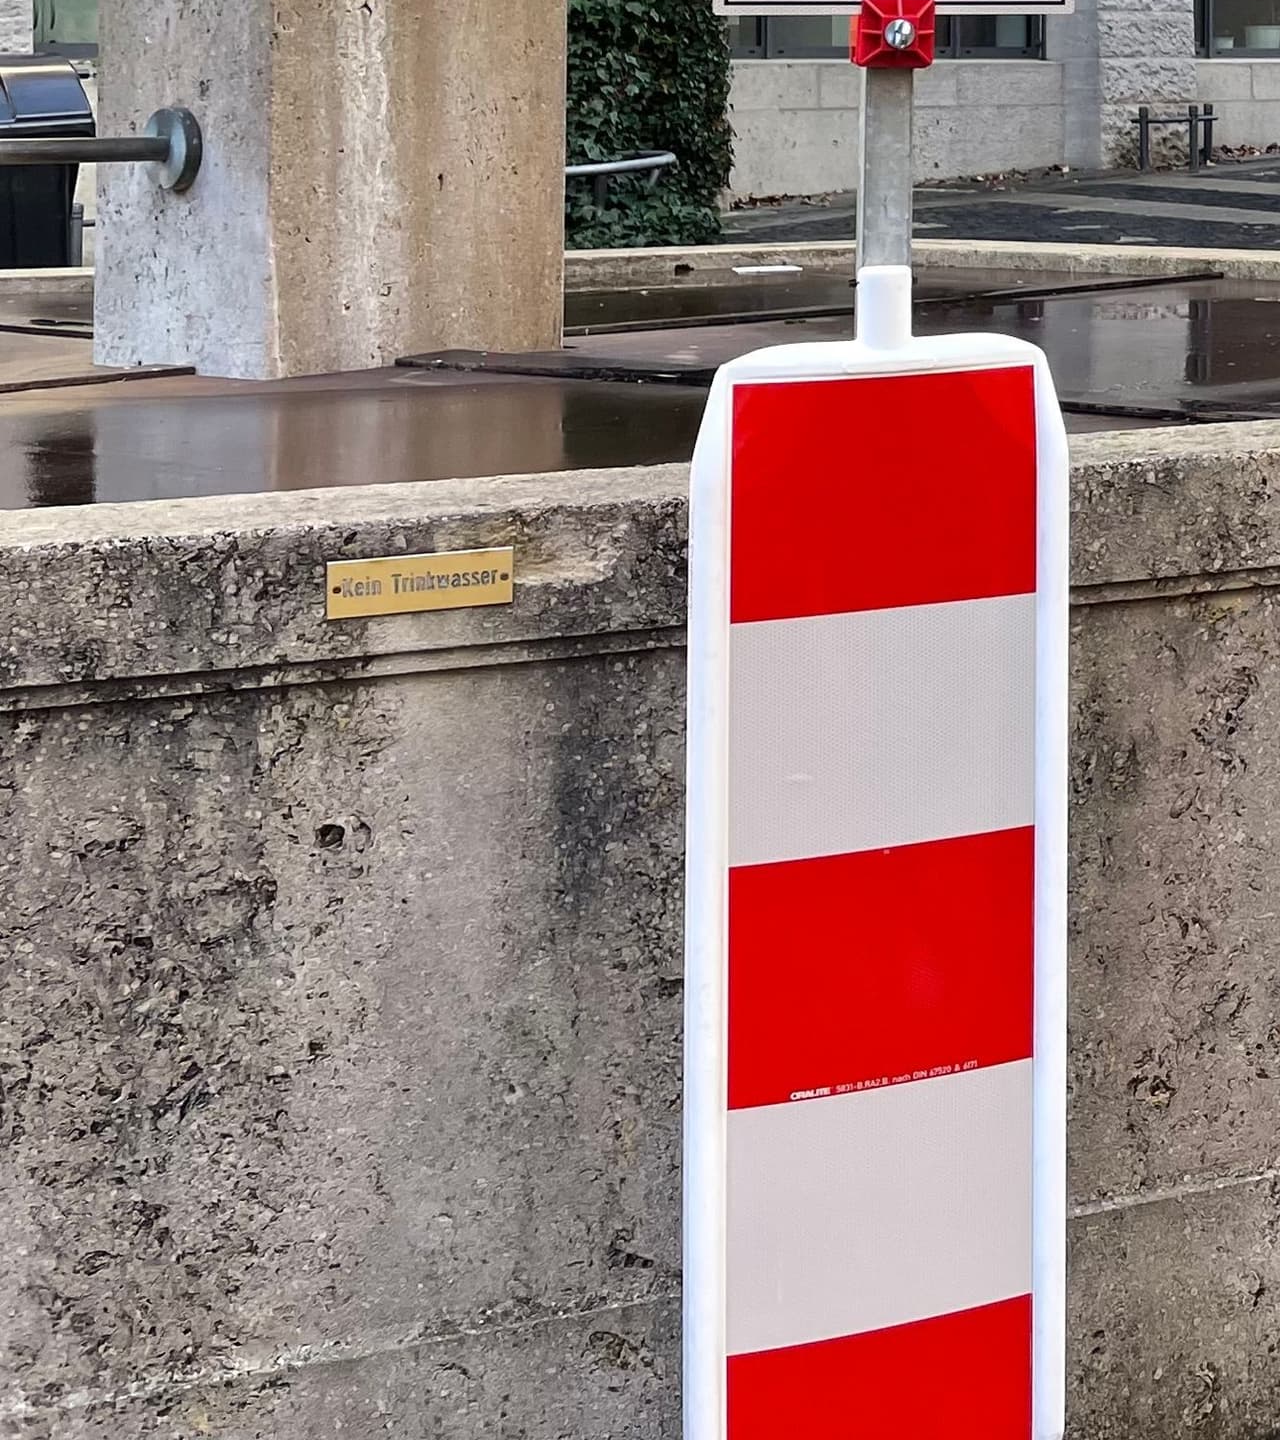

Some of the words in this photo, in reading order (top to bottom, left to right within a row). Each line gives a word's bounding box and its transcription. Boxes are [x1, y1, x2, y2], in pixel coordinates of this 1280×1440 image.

[341, 576, 382, 598] Kein
[391, 568, 499, 594] Trinkwasser
[912, 1069, 928, 1080] DIN
